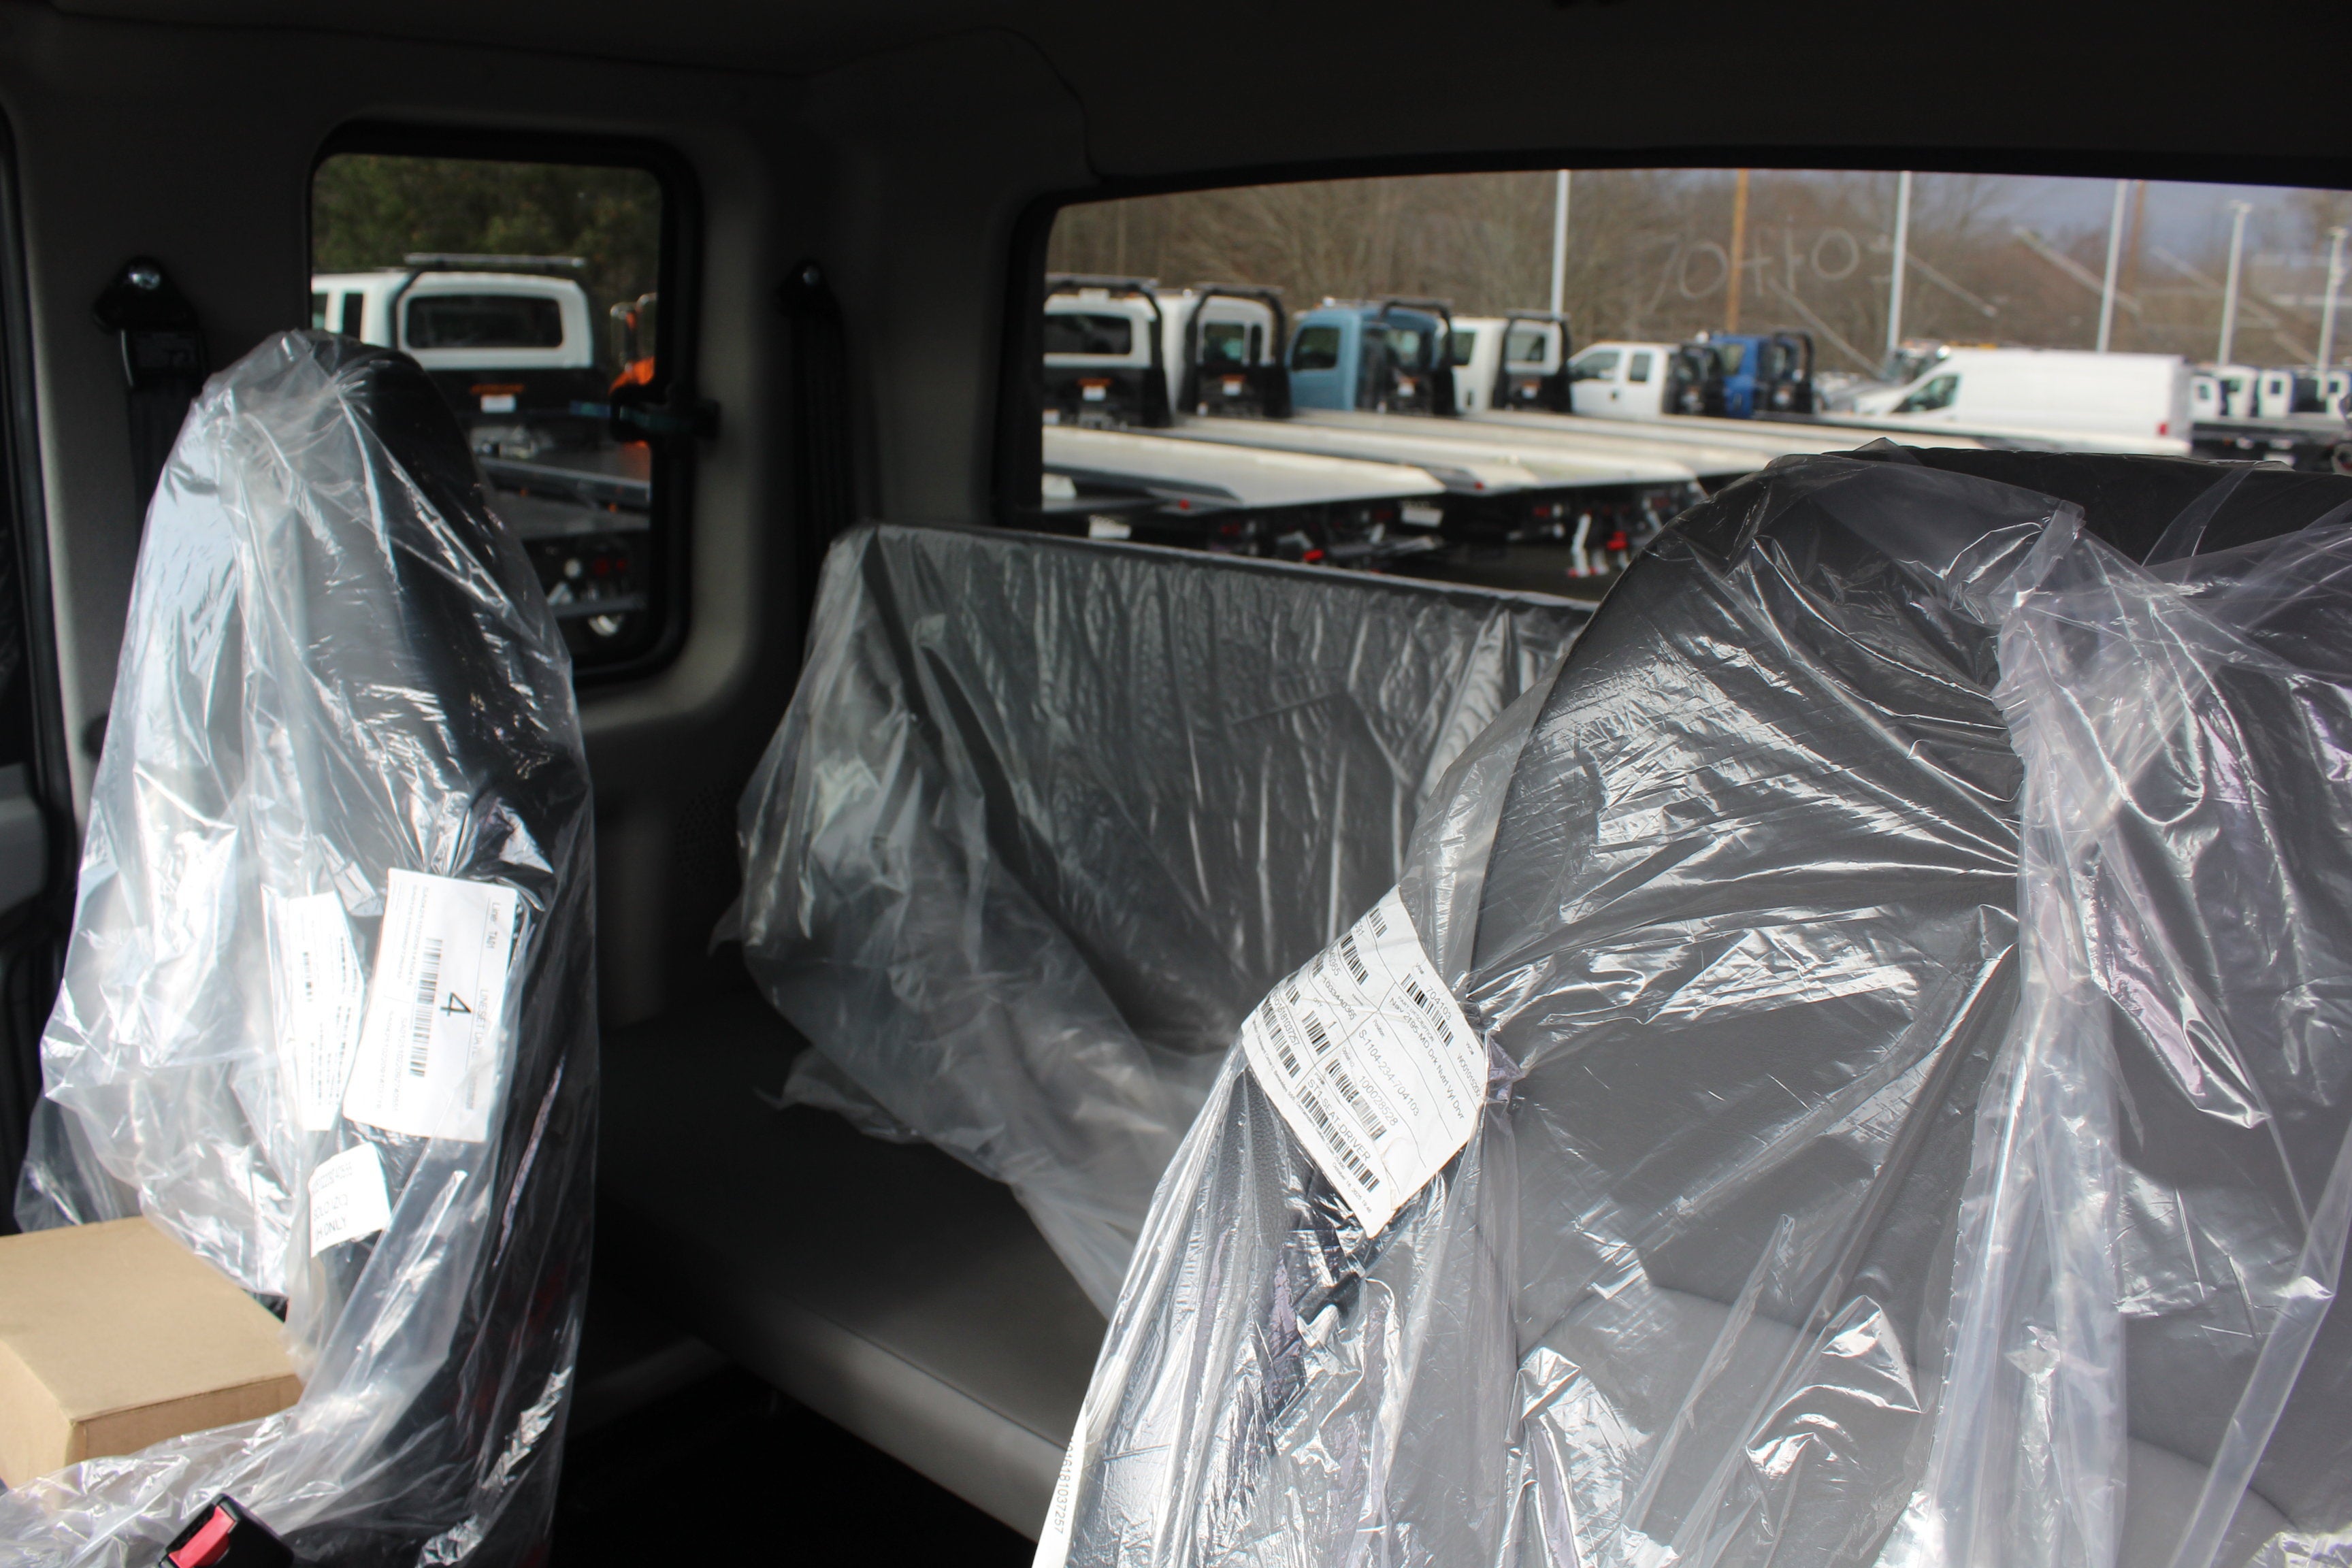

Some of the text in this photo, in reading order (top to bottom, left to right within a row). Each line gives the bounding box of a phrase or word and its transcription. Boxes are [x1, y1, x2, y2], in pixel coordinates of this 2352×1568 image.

[440, 992, 472, 1016] 4
[1322, 977, 1356, 1019] 1033440365
[1396, 995, 1435, 1042] PART DESCRIPTION
[1425, 986, 1453, 1020] 704103
[1326, 1021, 1337, 1029] 1
[1357, 1030, 1420, 1117] S-1104-234-704103
[1387, 998, 1405, 1014] Nav
[1403, 1012, 1431, 1049] 2195-MD
[1426, 1049, 1439, 1065] Drk
[1444, 1085, 1456, 1100] Vyl
[1453, 1101, 1465, 1119] Drvr
[1308, 1079, 1370, 1161] ST1-SEAT-DRIVER
[1358, 1076, 1398, 1126] 100028528
[323, 1215, 347, 1236] ONLY
